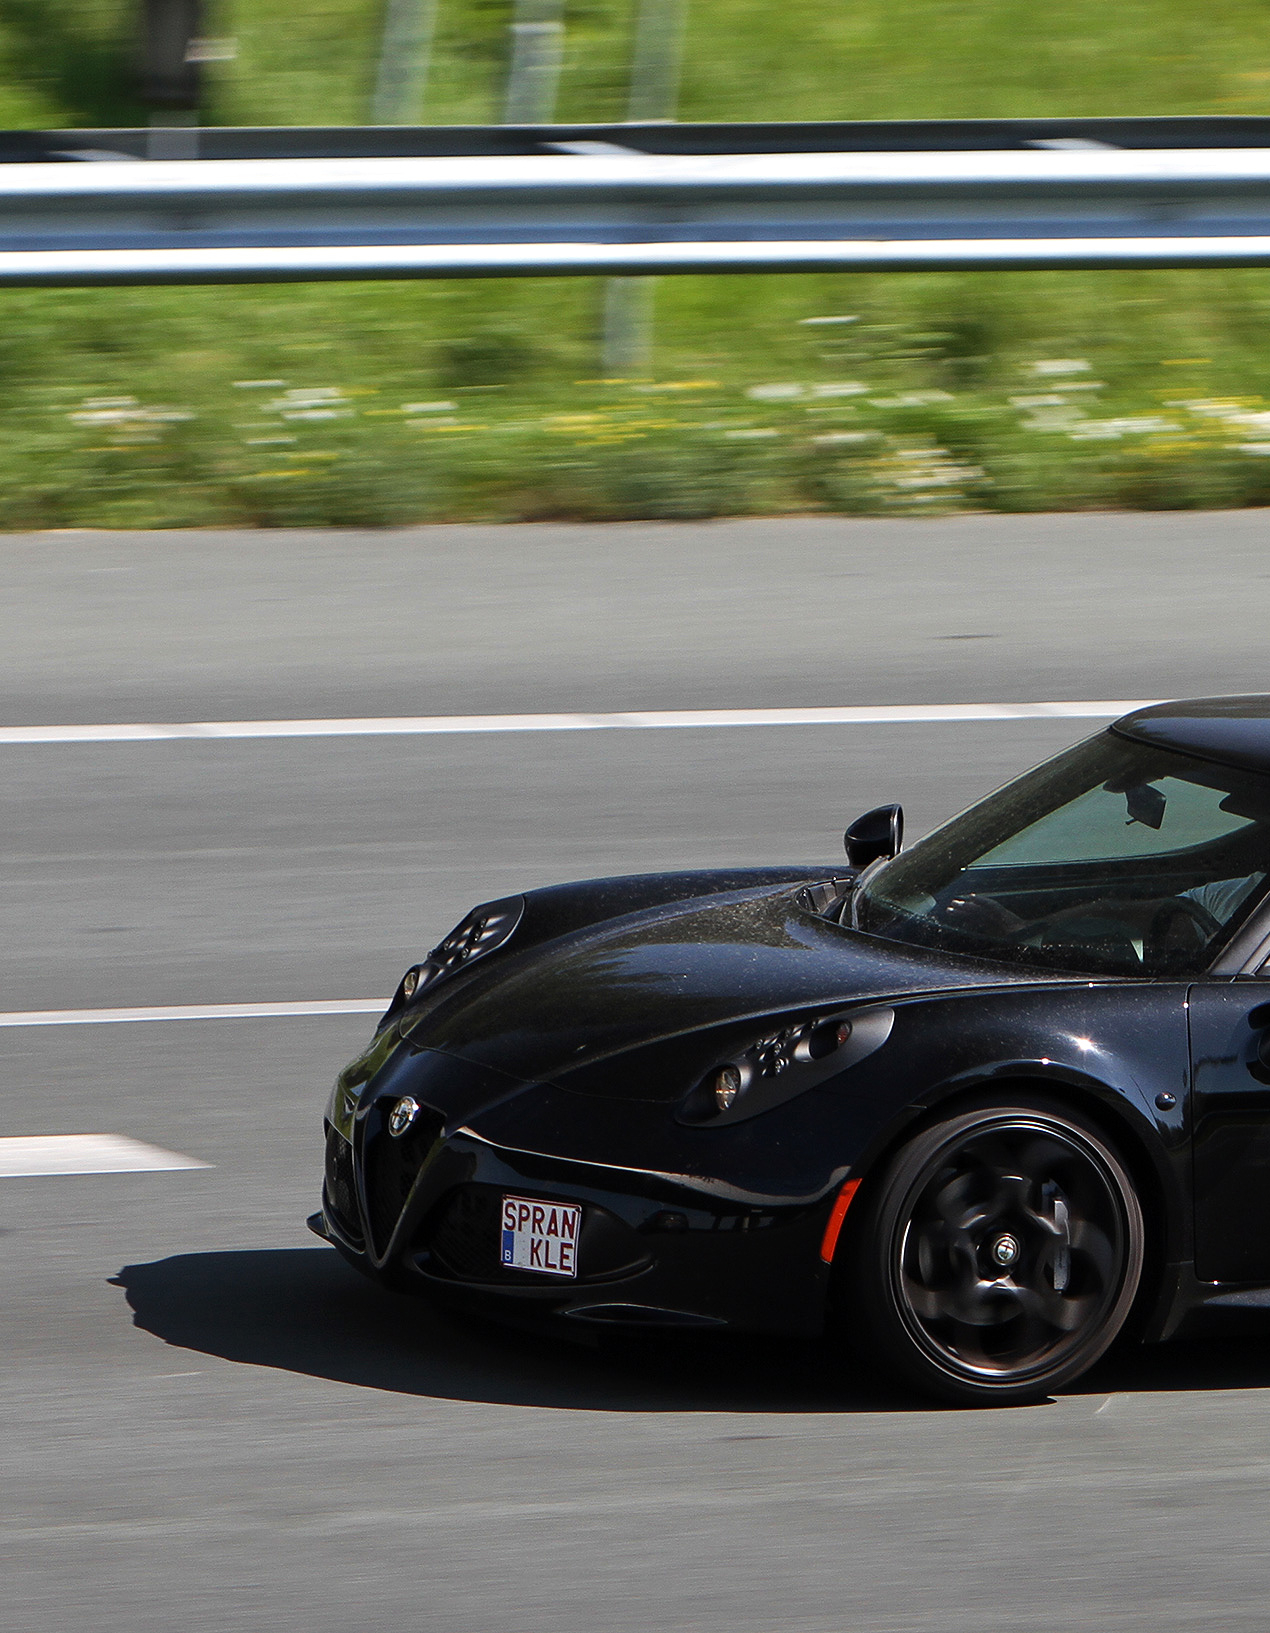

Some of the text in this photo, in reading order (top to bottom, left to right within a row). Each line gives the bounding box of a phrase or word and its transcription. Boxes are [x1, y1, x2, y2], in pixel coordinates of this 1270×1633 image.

[504, 1202, 577, 1239] SPRAN
[504, 1250, 512, 1260] B
[530, 1237, 573, 1271] KLE
